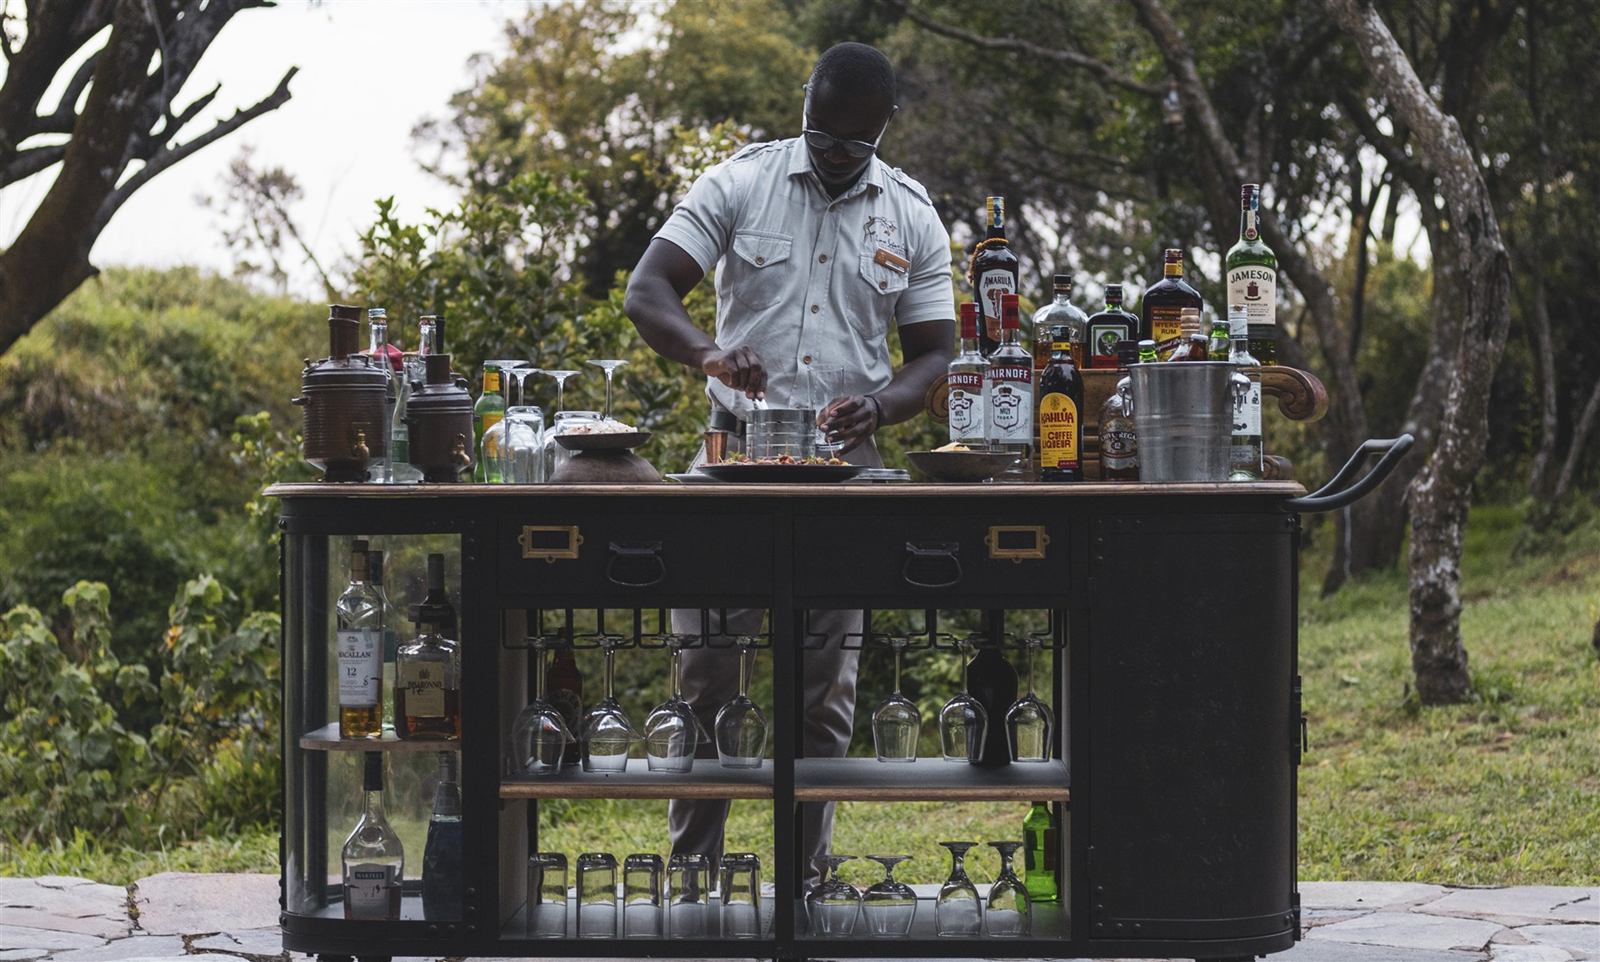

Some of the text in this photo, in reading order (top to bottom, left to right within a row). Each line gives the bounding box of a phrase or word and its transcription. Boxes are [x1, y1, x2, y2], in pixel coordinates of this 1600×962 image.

[1230, 269, 1273, 283] JAMESON
[983, 275, 1013, 289] AMARULA
[1041, 408, 1075, 424] KAHLÚA
[1047, 431, 1072, 440] COFFEE
[1042, 440, 1071, 449] LIQUEUR
[347, 667, 358, 676] 12
